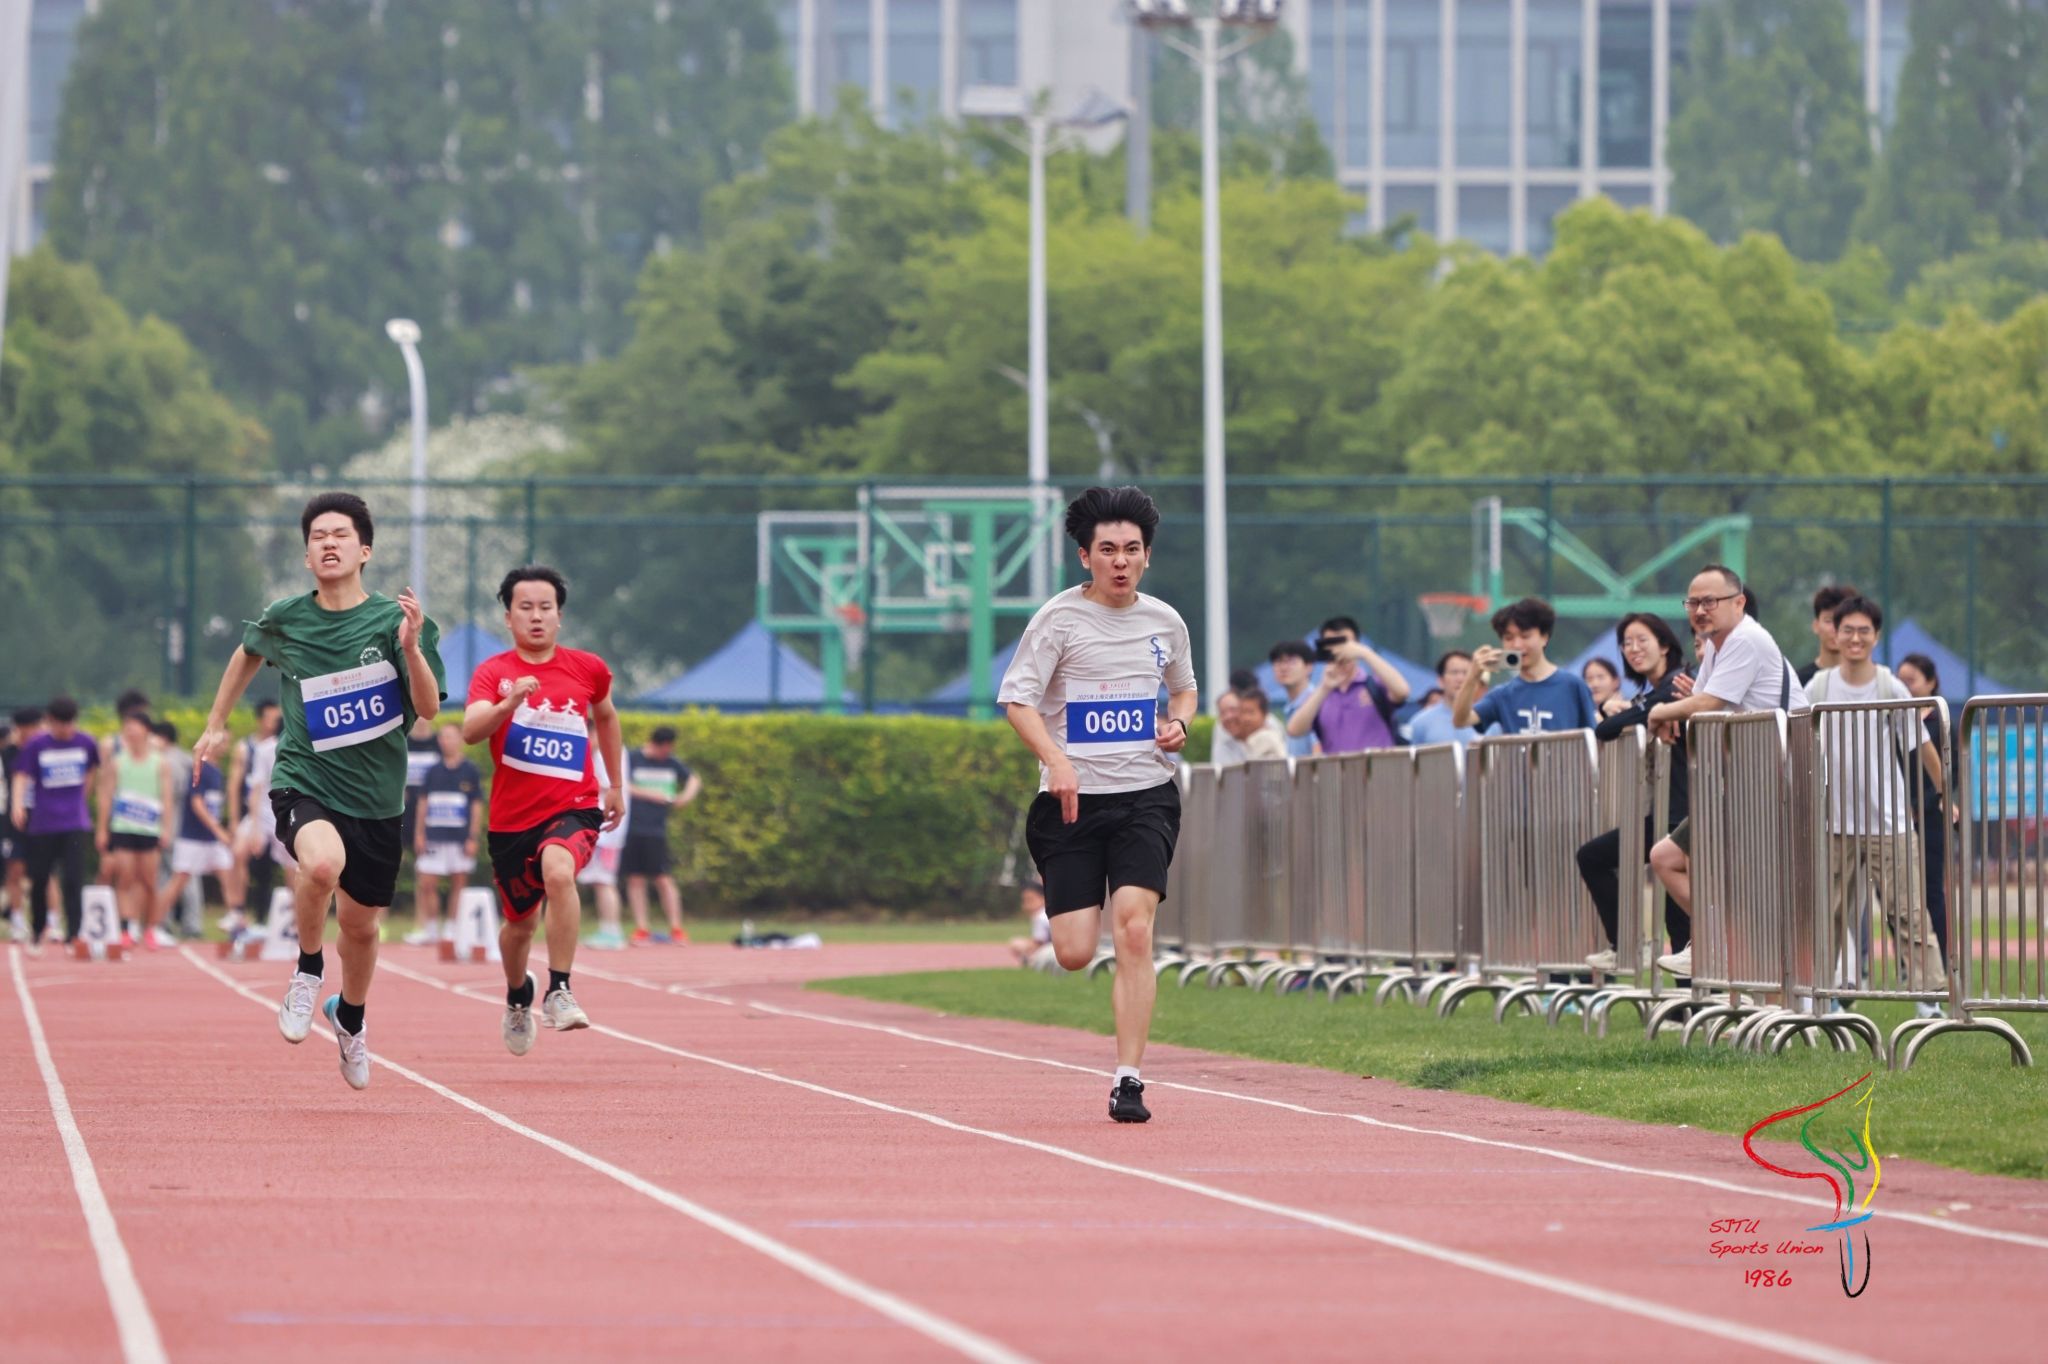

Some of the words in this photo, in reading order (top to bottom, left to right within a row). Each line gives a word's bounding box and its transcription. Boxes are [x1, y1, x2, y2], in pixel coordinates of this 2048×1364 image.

[324, 695, 385, 728] 0516
[1085, 709, 1143, 734] 0603
[522, 735, 573, 762] 1503
[90, 904, 107, 940] 3
[470, 904, 485, 940] 1
